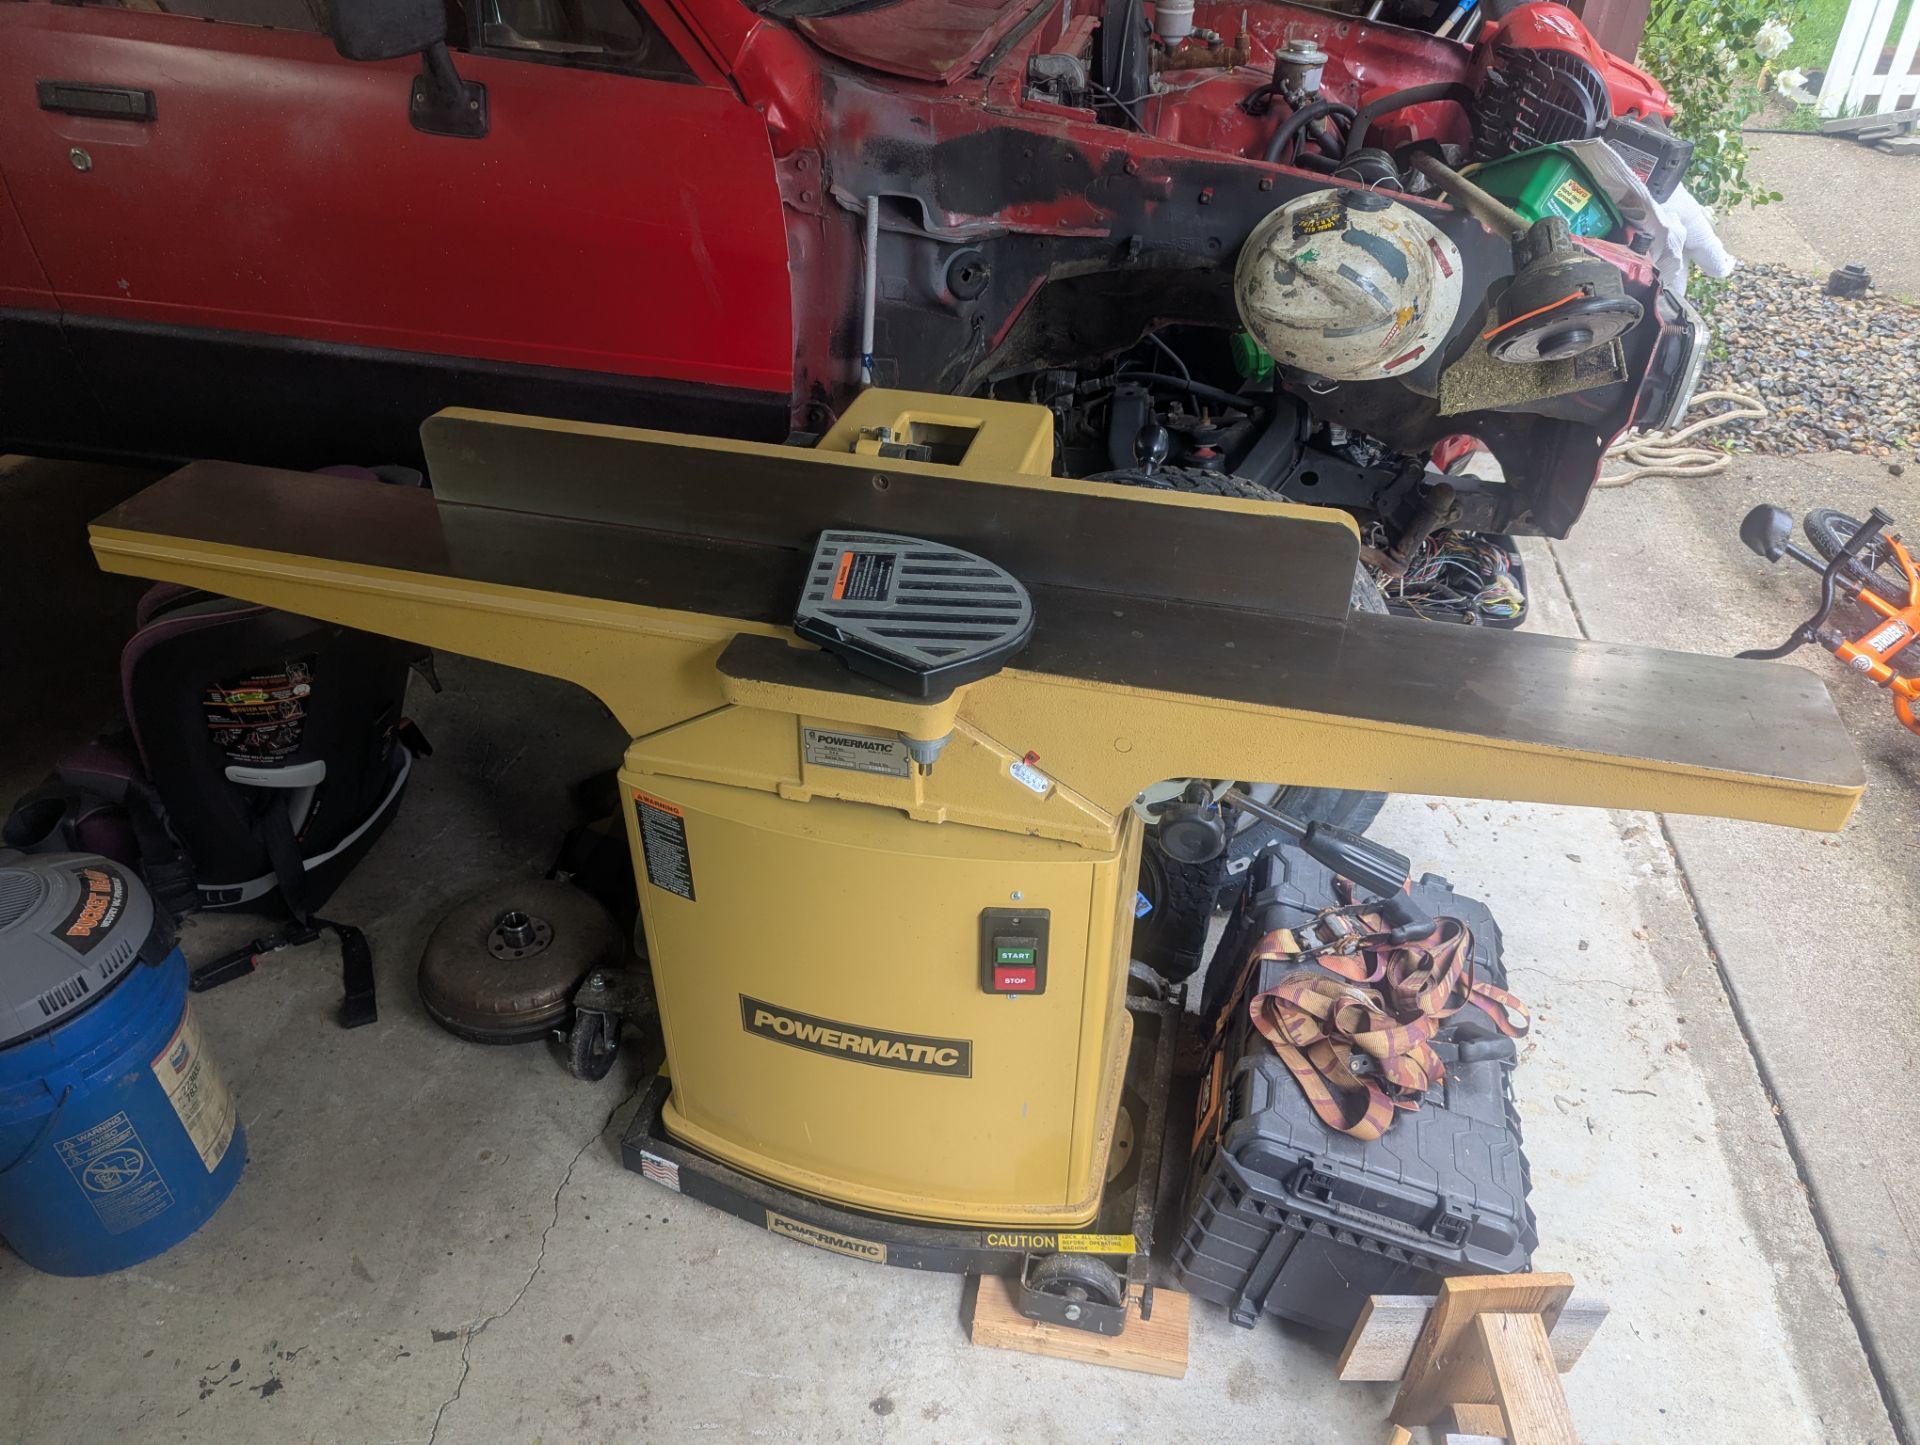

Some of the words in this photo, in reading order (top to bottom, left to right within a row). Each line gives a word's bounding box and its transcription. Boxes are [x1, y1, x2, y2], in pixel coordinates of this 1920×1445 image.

[817, 735, 893, 753] POWERMATIC
[644, 796, 680, 814] WARNING
[66, 892, 111, 936] BUCKET
[754, 1009, 960, 1067] POWERMATIC
[76, 1116, 122, 1142] WARNING
[90, 1129, 118, 1147] AVISO
[774, 1218, 880, 1256] POWERMATIC
[987, 1233, 1055, 1248] CAUTION
